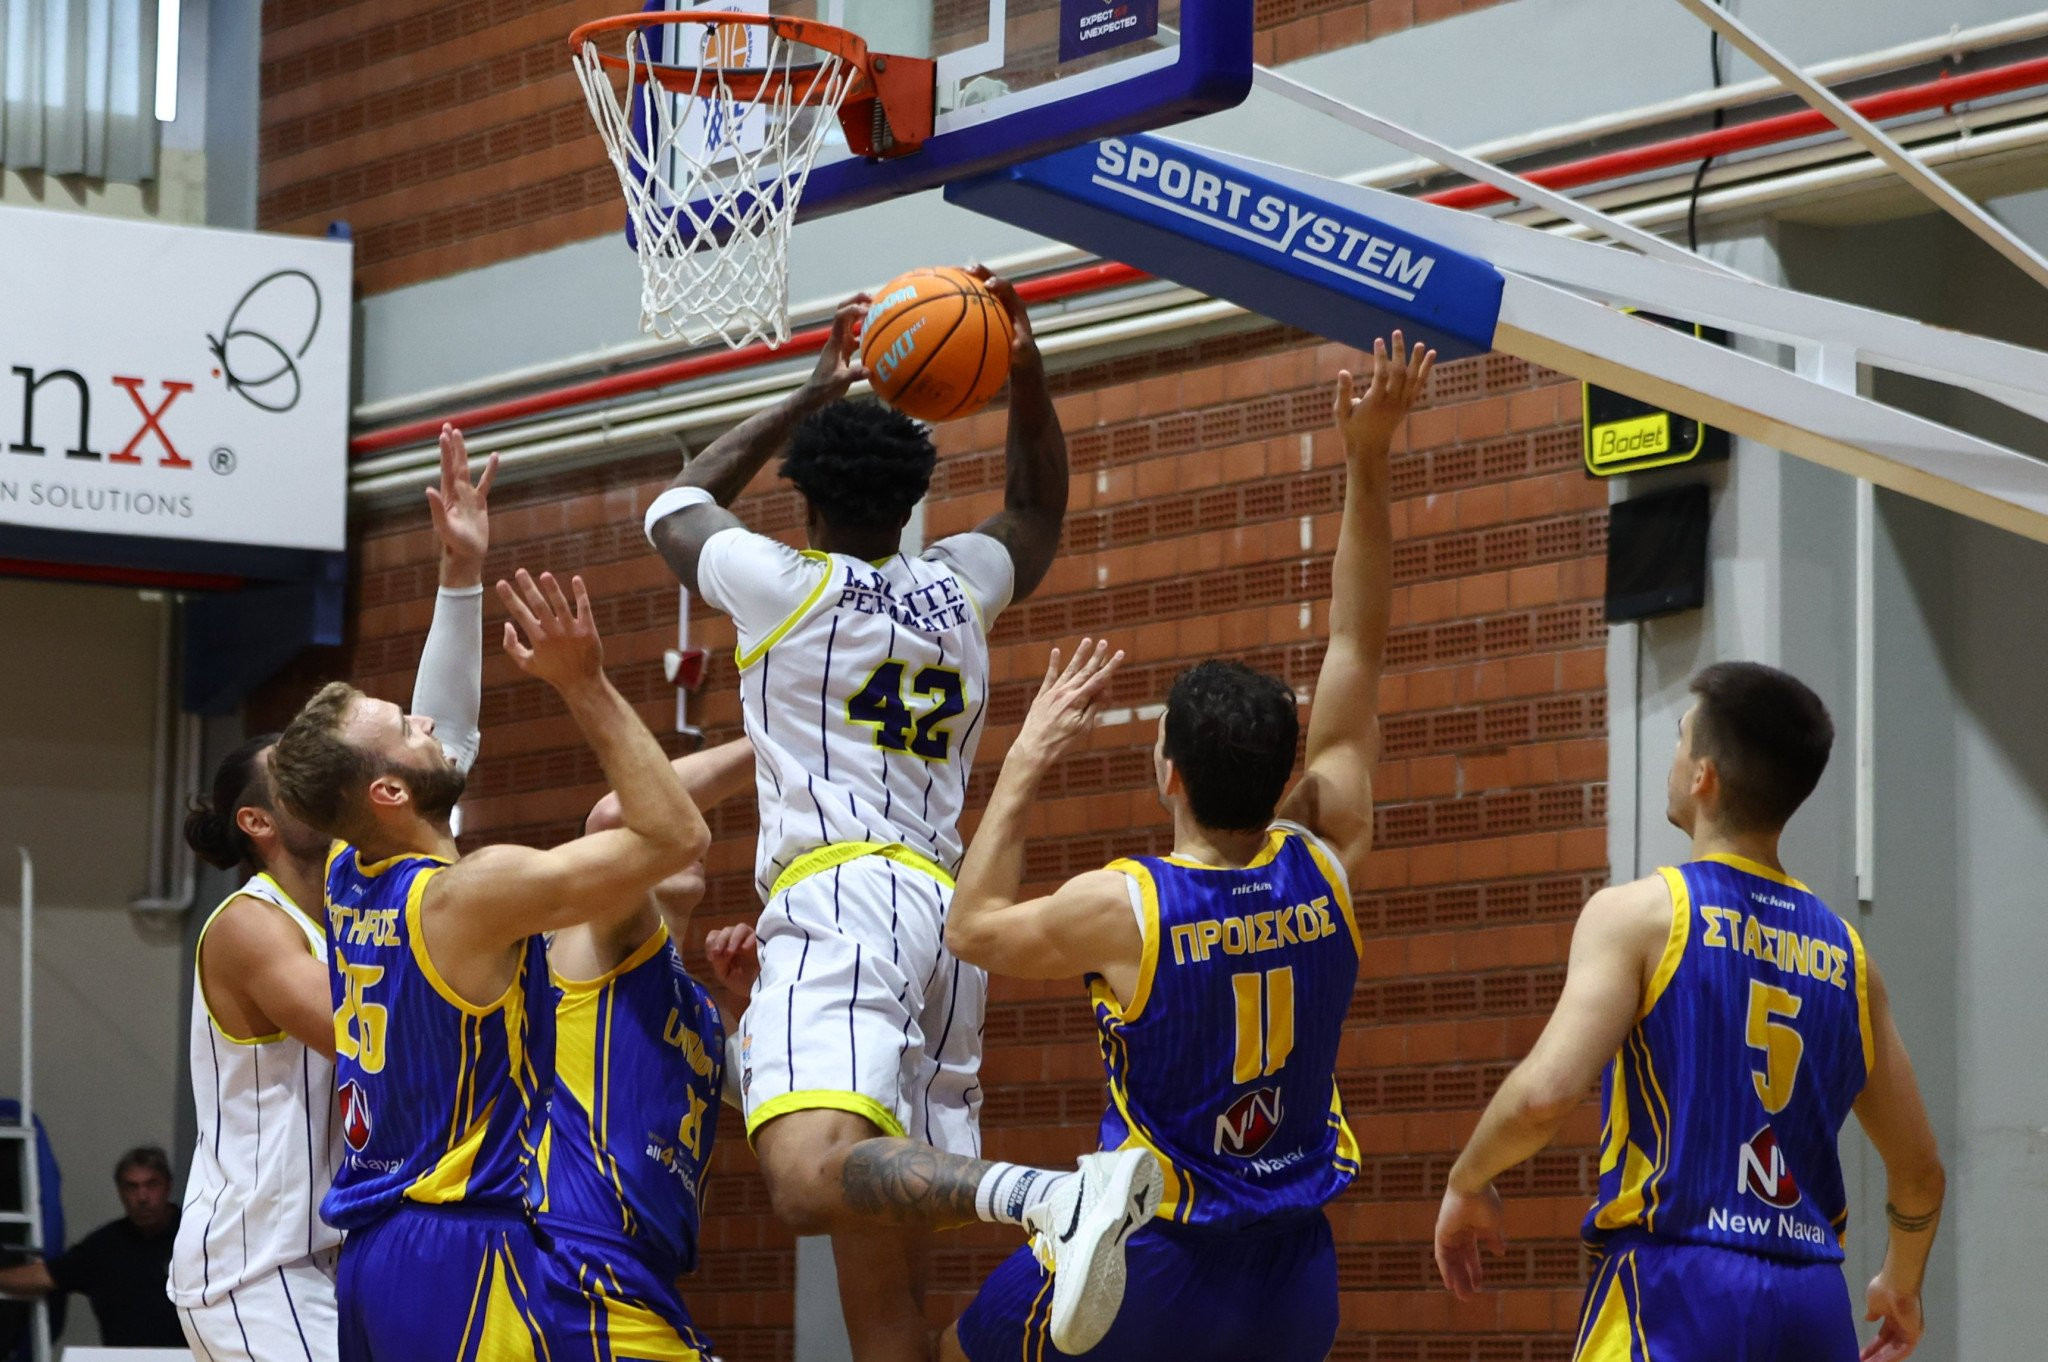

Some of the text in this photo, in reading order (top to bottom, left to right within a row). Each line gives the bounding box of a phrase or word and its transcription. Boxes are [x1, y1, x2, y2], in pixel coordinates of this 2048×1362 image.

[1080, 9, 1113, 28] EXPECT
[1080, 16, 1137, 41] UNEXPECTED
[1096, 138, 1436, 290] SPORT SYSTEM
[0, 366, 193, 469] nx
[1599, 425, 1664, 457] Bodet
[30, 483, 193, 519] SOLUTIONS
[844, 656, 969, 765] 42
[1170, 895, 1337, 966] ΠΡΟΙΣΚΟΣ
[1700, 905, 1848, 991] ΣΤΑΣΙΝΟΣ
[1231, 965, 1295, 1085] 11
[1745, 978, 1804, 1115] 5
[1251, 1145, 1306, 1179] Naval
[1708, 1206, 1770, 1236] New
